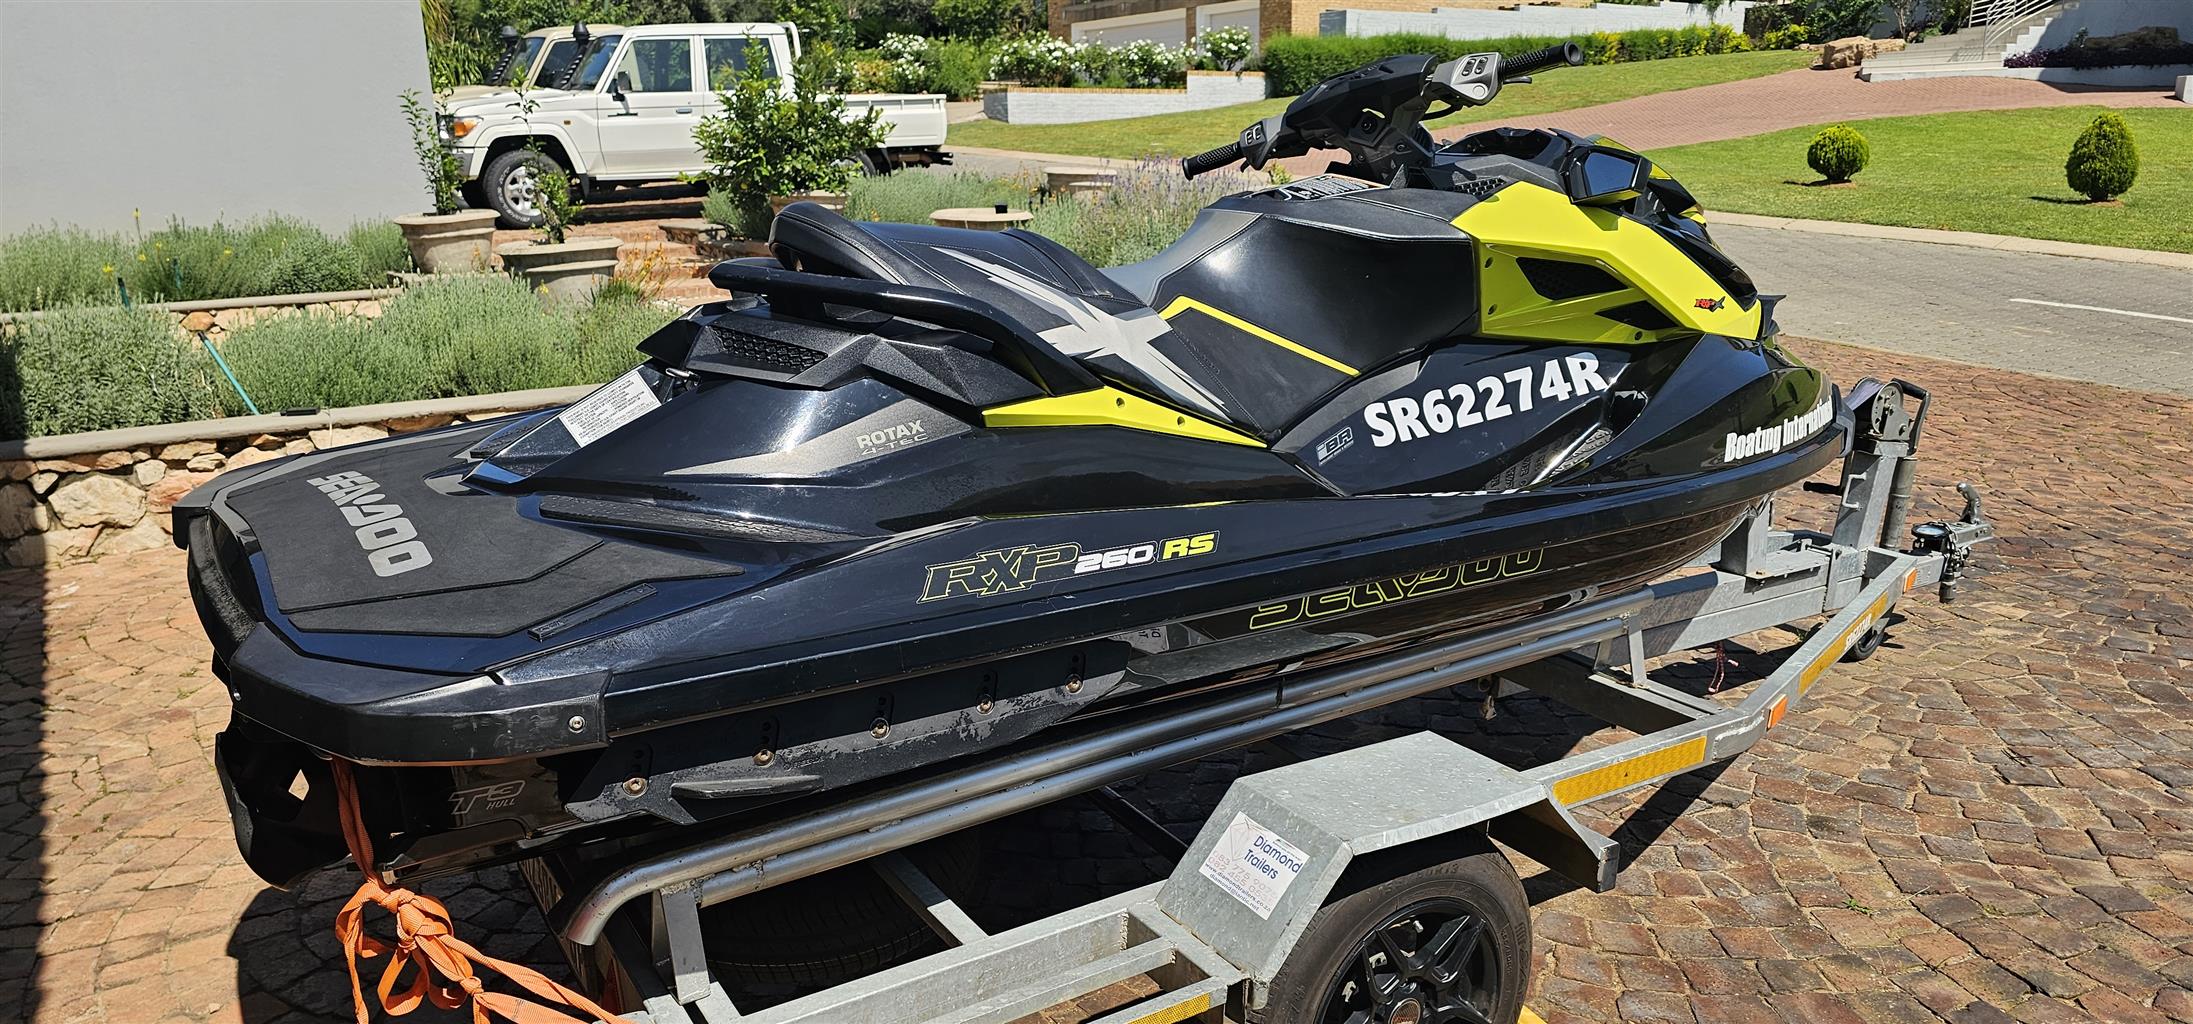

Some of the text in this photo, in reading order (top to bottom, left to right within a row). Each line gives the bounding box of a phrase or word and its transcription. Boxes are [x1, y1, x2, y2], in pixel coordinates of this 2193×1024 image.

[1363, 351, 1610, 448] SR62274R
[856, 420, 925, 449] ROTAX
[1724, 426, 1782, 463] Boating
[918, 533, 1216, 603] RXP 260 RS
[448, 780, 526, 815] T3
[485, 798, 516, 810] HULL
[1243, 848, 1279, 880] Trailers
[1253, 835, 1304, 874] Diamond
